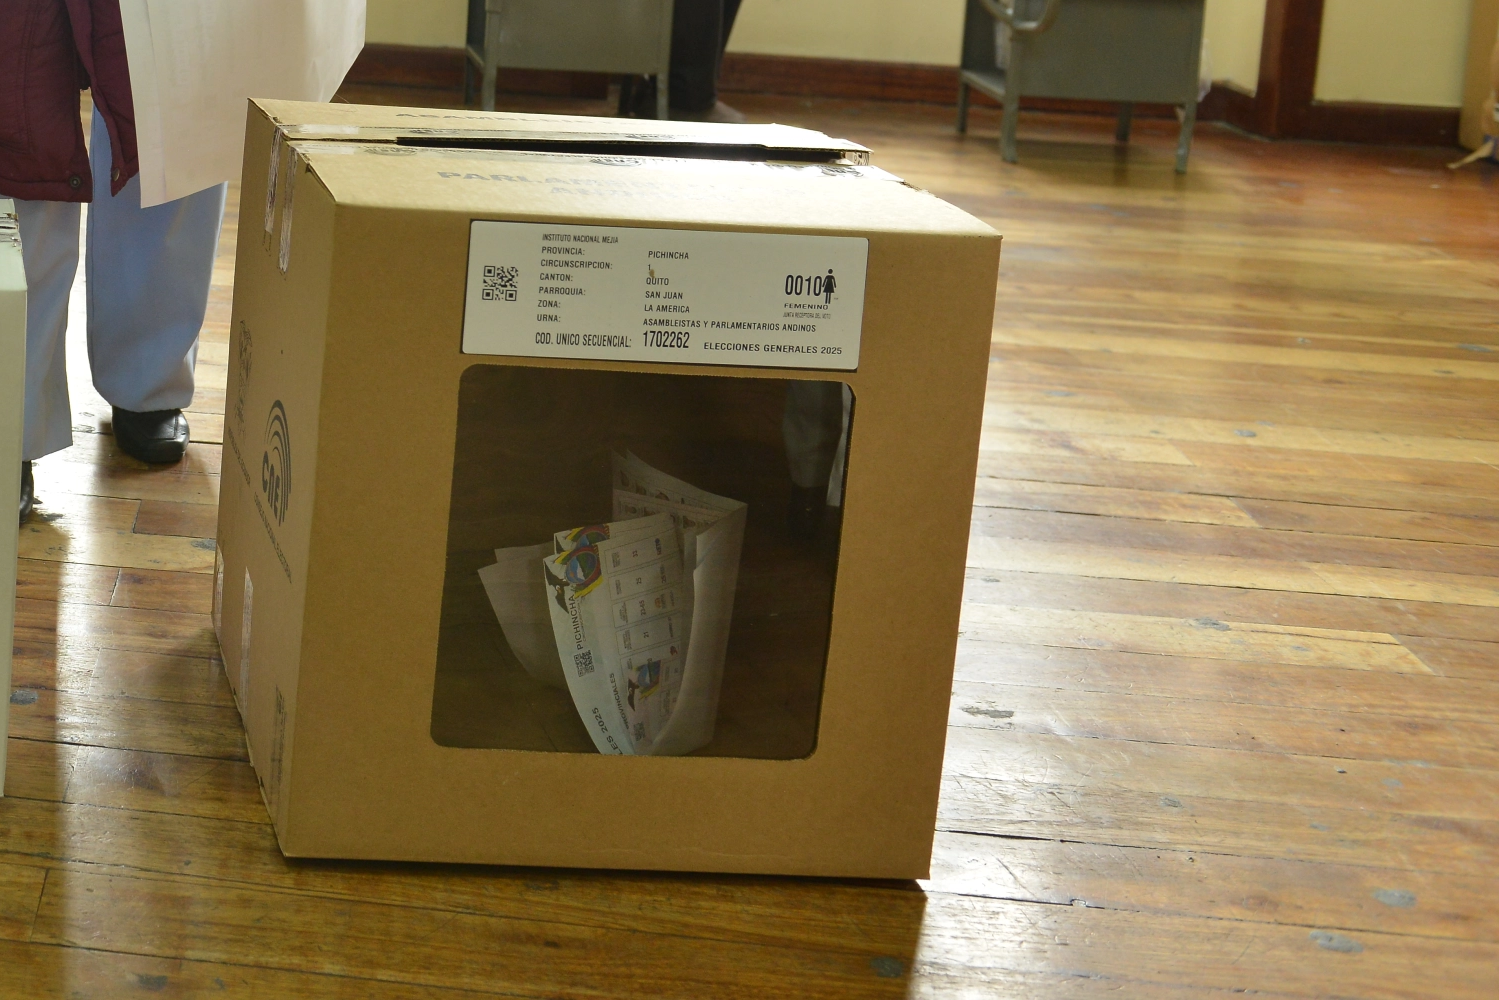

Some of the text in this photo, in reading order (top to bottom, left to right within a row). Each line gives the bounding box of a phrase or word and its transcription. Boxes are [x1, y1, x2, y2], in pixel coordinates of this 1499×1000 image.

[542, 234, 619, 244] INSTITUTO NACIONAL MEJIA
[541, 246, 585, 255] PROVINCIA:
[648, 251, 689, 259] PICHINCHA
[540, 259, 613, 269] CIRCUNSCRIPCION:
[539, 272, 573, 281] CANTON:
[646, 277, 669, 285] QUITO
[785, 274, 822, 296] 0010
[538, 286, 586, 295] PARROQUIA:
[645, 291, 683, 300] SAN JUAN
[537, 300, 561, 308] ZONA:
[644, 304, 690, 313] LA AMERICA
[536, 314, 561, 322] URNA:
[643, 318, 701, 328] ASAMBLEISTAS
[711, 321, 780, 331] PARLAMENTARIOS
[782, 323, 816, 332] ANDINOS
[535, 330, 690, 348] COD. UNICO SECUENCIAL: 1702262
[704, 342, 842, 355] ELECCIONES GENERALES 2025
[568, 594, 584, 650] PICHINCHA
[609, 673, 629, 730] PROVINCIALES
[592, 707, 623, 755] LES 2025
